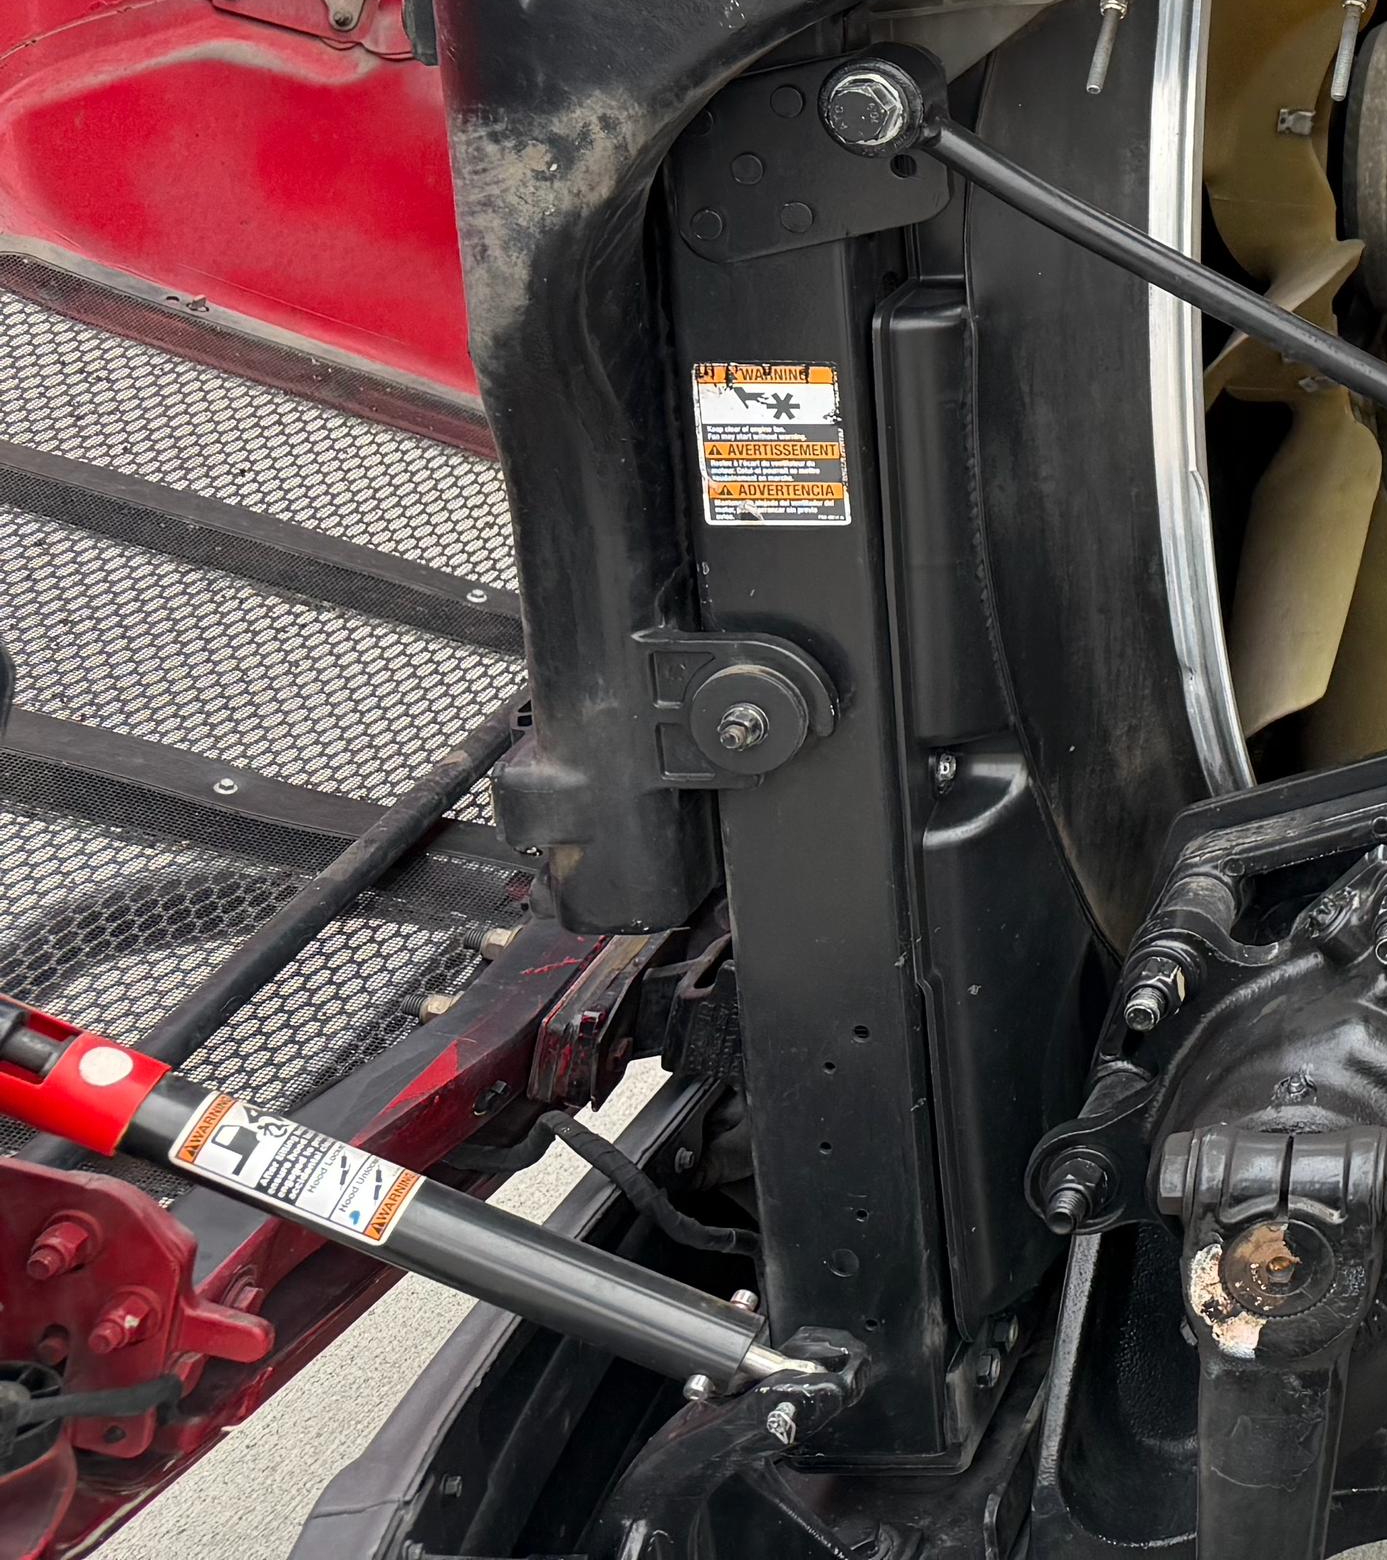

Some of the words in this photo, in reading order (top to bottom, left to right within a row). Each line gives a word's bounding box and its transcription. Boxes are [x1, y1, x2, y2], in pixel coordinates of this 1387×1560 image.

[728, 444, 836, 456] AVERTISSEMENT
[738, 484, 835, 497] ADVERTENCIA
[192, 1095, 233, 1146] WARNING
[307, 1166, 330, 1194] Hood
[338, 1184, 359, 1214] Hood
[378, 1172, 417, 1222] WARNING
